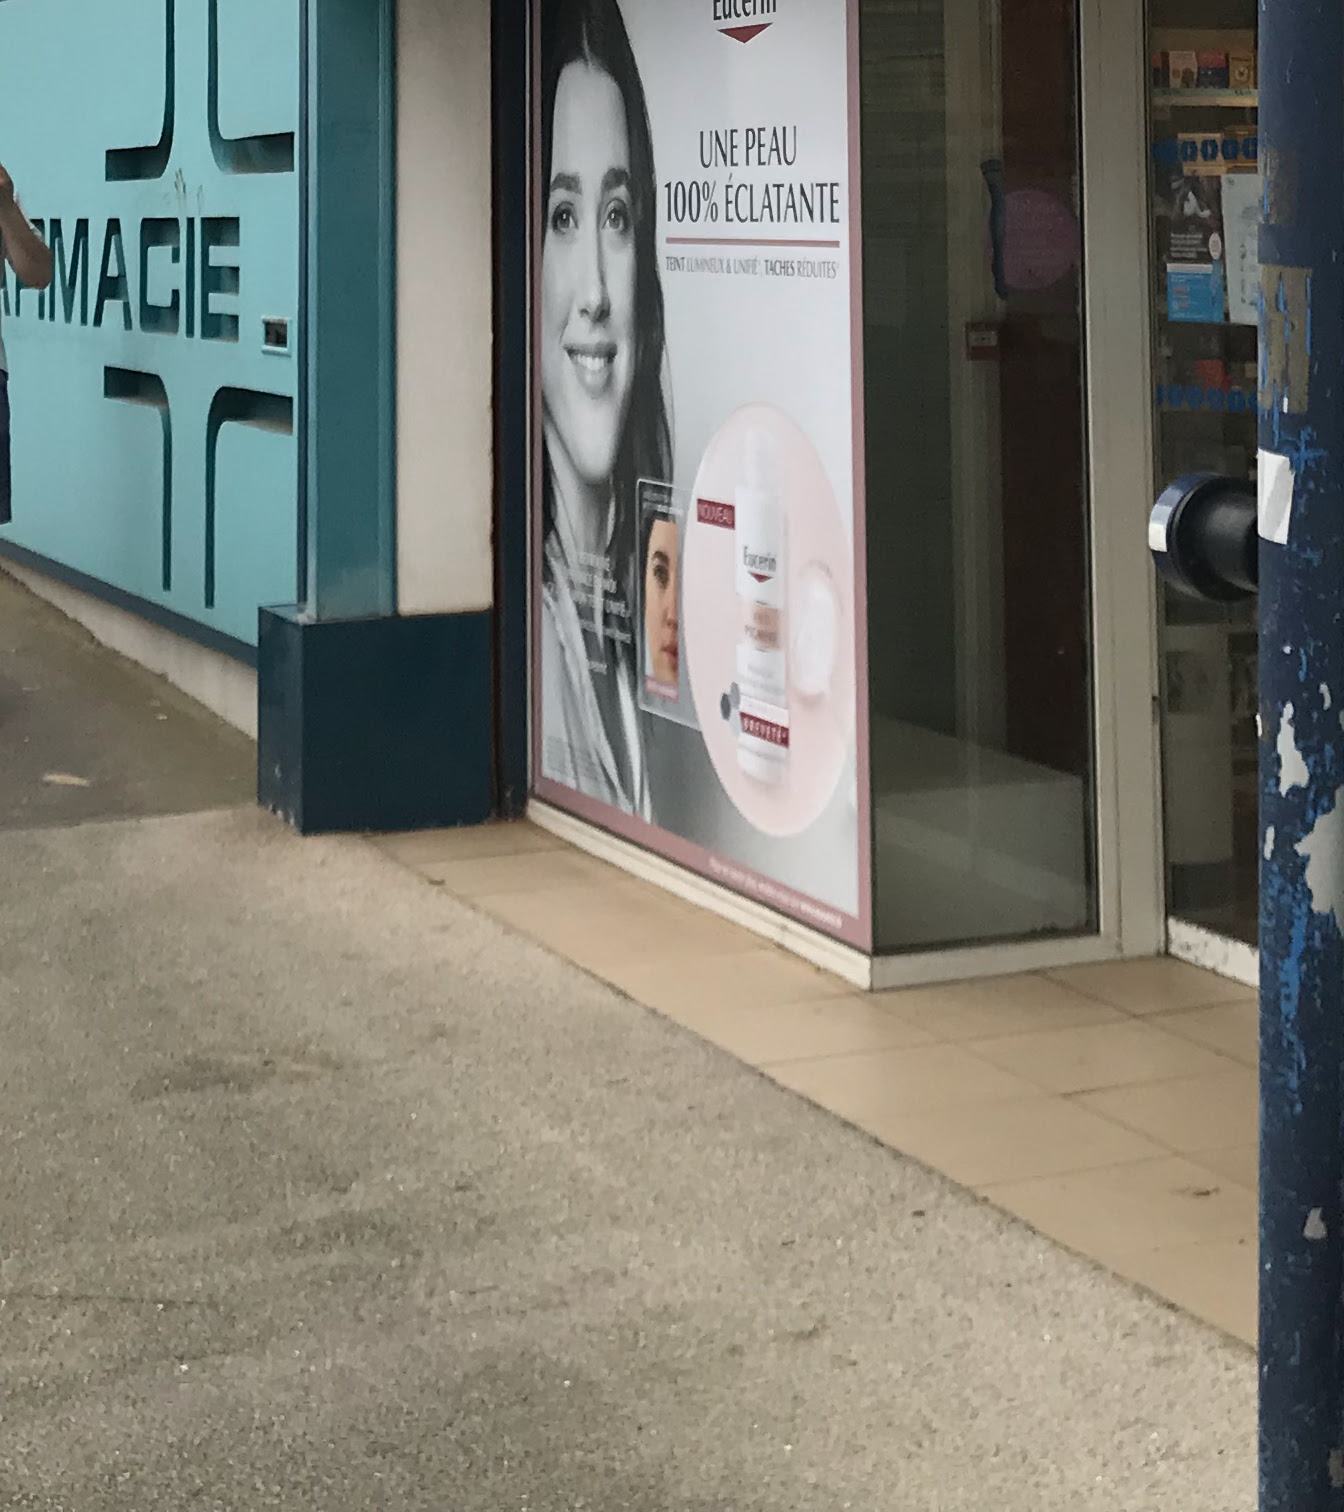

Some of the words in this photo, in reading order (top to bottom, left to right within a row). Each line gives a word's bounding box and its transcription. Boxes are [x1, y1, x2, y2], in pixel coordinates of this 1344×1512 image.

[699, 129, 739, 168] UNE
[745, 125, 797, 166] PEAU
[664, 180, 718, 223] 100%
[725, 172, 840, 223] ÉCLATANTE
[665, 256, 685, 272] TEINT
[764, 259, 795, 277] TACHES
